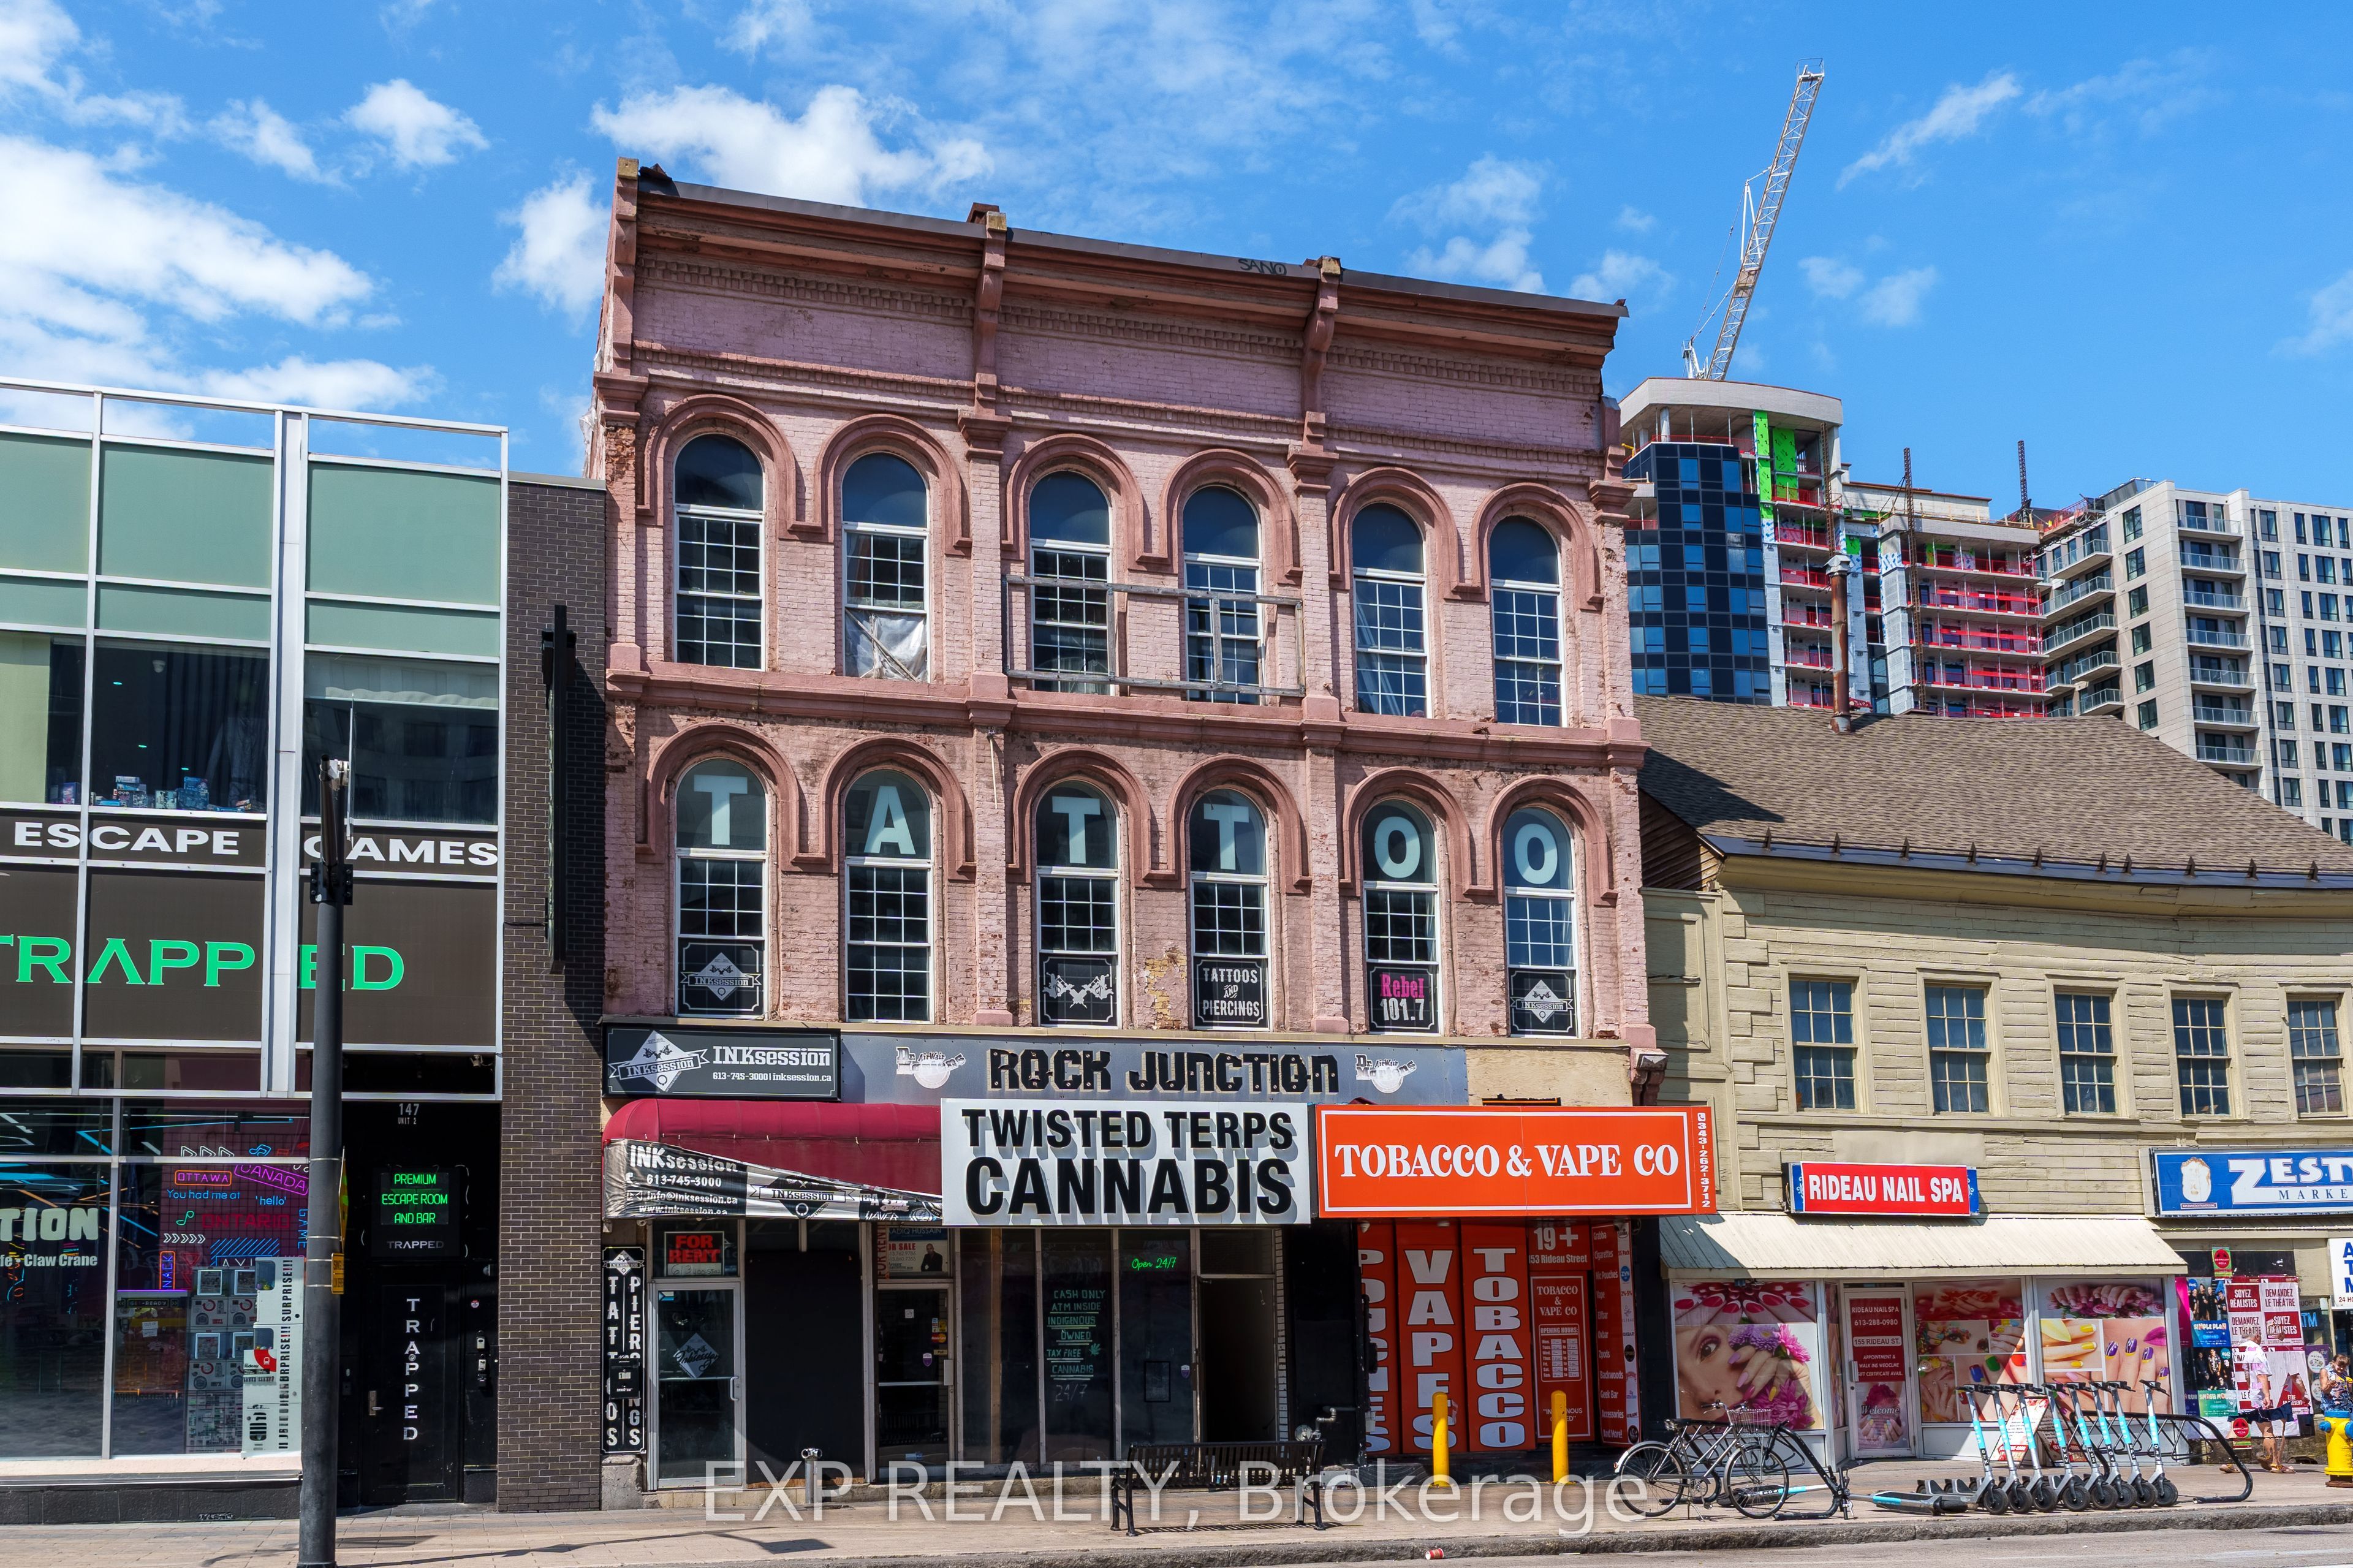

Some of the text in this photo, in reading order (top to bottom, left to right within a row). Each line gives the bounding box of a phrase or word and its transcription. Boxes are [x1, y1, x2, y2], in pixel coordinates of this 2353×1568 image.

[15, 822, 239, 855] ESCAPE
[0, 934, 404, 991] RAPPED
[694, 975, 749, 987] INKsession
[1203, 968, 1257, 983] TATTOOS
[1380, 972, 1425, 998] Rebel
[1224, 985, 1238, 999] AND
[1202, 1000, 1260, 1017] PIERCINGS
[1380, 998, 1425, 1021] 101.7
[1521, 1001, 1564, 1010] INKsession
[713, 1046, 832, 1066] INKsession
[1355, 1055, 1373, 1067] Dr.
[626, 1057, 694, 1077] INKsession
[988, 1048, 1339, 1093] ROCK JUNCTION
[713, 1072, 832, 1081] 613-745-3000 inksession.ca
[398, 1103, 419, 1116] 147
[961, 1108, 1293, 1150] TWISTED TERPS
[630, 1145, 738, 1172] INKsession
[1335, 1144, 1679, 1178] TOBACCO & VAPE CO
[1697, 1122, 1710, 1208] 343-262-3712
[178, 1173, 229, 1183] OTTAWA
[241, 1164, 306, 1191] CANADA
[394, 1173, 436, 1185] PREMIUM
[646, 1173, 722, 1187] 613-745-3000
[966, 1156, 1293, 1215] CANNABIS
[1808, 1174, 1965, 1203] RIDEAU NAIL SPA
[167, 1189, 184, 1200] You
[189, 1190, 208, 1200] had
[230, 1191, 241, 1200] at
[382, 1194, 448, 1205] ESCAPE ROOM
[771, 1189, 834, 1201] INKsession
[2279, 1188, 2348, 1200] MARKE
[0, 1208, 99, 1241] TION
[202, 1213, 290, 1229] ONTARIO
[394, 1213, 436, 1224] AND BAR
[387, 1241, 444, 1249] TRAPPED
[676, 1235, 713, 1248] FOR
[24, 1254, 56, 1267] Claw
[59, 1254, 97, 1267] Crane
[669, 1249, 721, 1263] RENT
[1529, 1254, 1588, 1263] 153 Rideau Street
[1132, 1257, 1176, 1271] Open 24/7
[1053, 1289, 1106, 1298] CASH ONLY
[1537, 1286, 1578, 1295] TOBACCO
[2234, 1289, 2252, 1298] SOYEZ
[2265, 1289, 2294, 1297] DEMANDEZ
[1051, 1301, 1101, 1311] ATM INSIDE
[1555, 1296, 1561, 1305] &
[2230, 1297, 2257, 1308] RÉALISTES
[2265, 1298, 2272, 1307] LE
[1539, 1306, 1577, 1316] VAPE CO
[1048, 1316, 1096, 1325] INDIGENOUS
[2232, 1317, 2260, 1325] DEMANDEZ
[2273, 1316, 2290, 1325] SOYEZ
[1061, 1331, 1091, 1340] OWNED
[2232, 1327, 2238, 1335] LE
[1047, 1349, 1061, 1357] TAX
[1404, 1250, 1457, 1449] VAPES
[1473, 1248, 1525, 1447] TOBACCO
[606, 1276, 619, 1446] TATTOS
[629, 1276, 641, 1446] PIERGS
[403, 1298, 420, 1441] TRAPPED
[1052, 1365, 1094, 1374] CANNABIS
[1055, 1384, 1088, 1401] 24/7
[1861, 1404, 1900, 1415] Welcome
